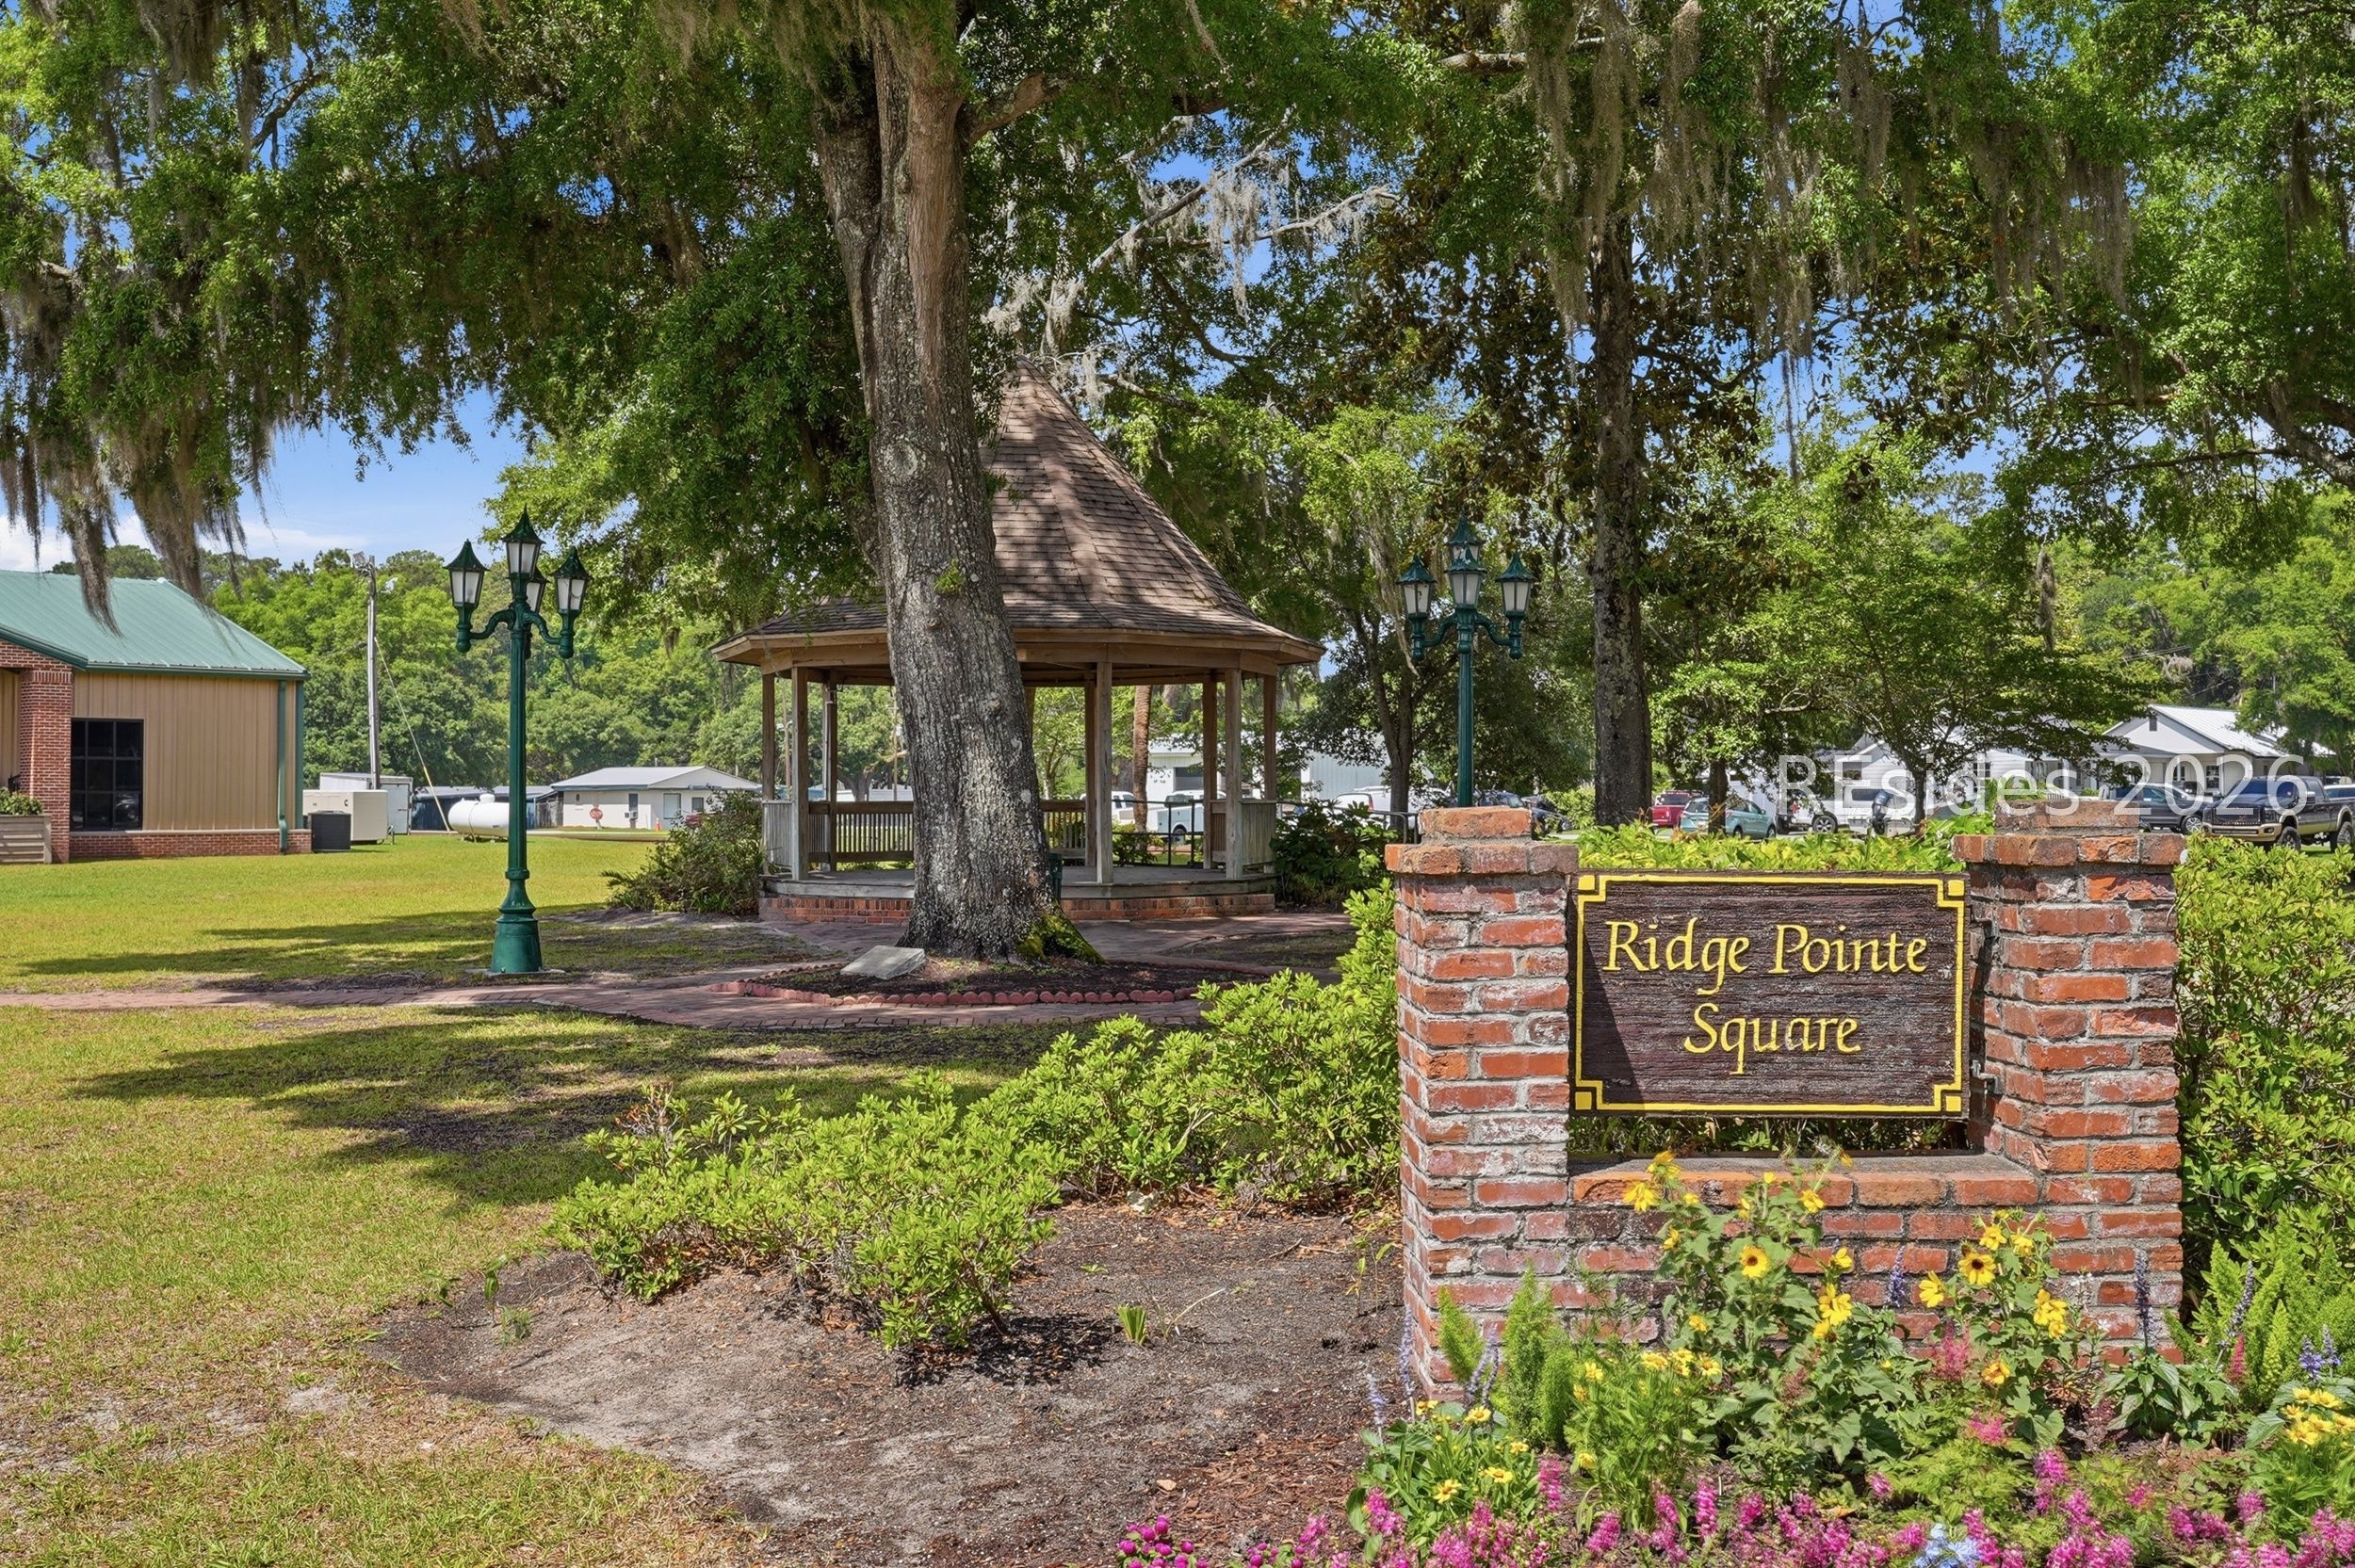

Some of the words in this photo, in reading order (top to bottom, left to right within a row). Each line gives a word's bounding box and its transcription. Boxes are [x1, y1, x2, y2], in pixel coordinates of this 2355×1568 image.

[1602, 917, 1749, 995] Ridge
[1768, 924, 1928, 974] Pointe
[1684, 1002, 1861, 1075] Square
